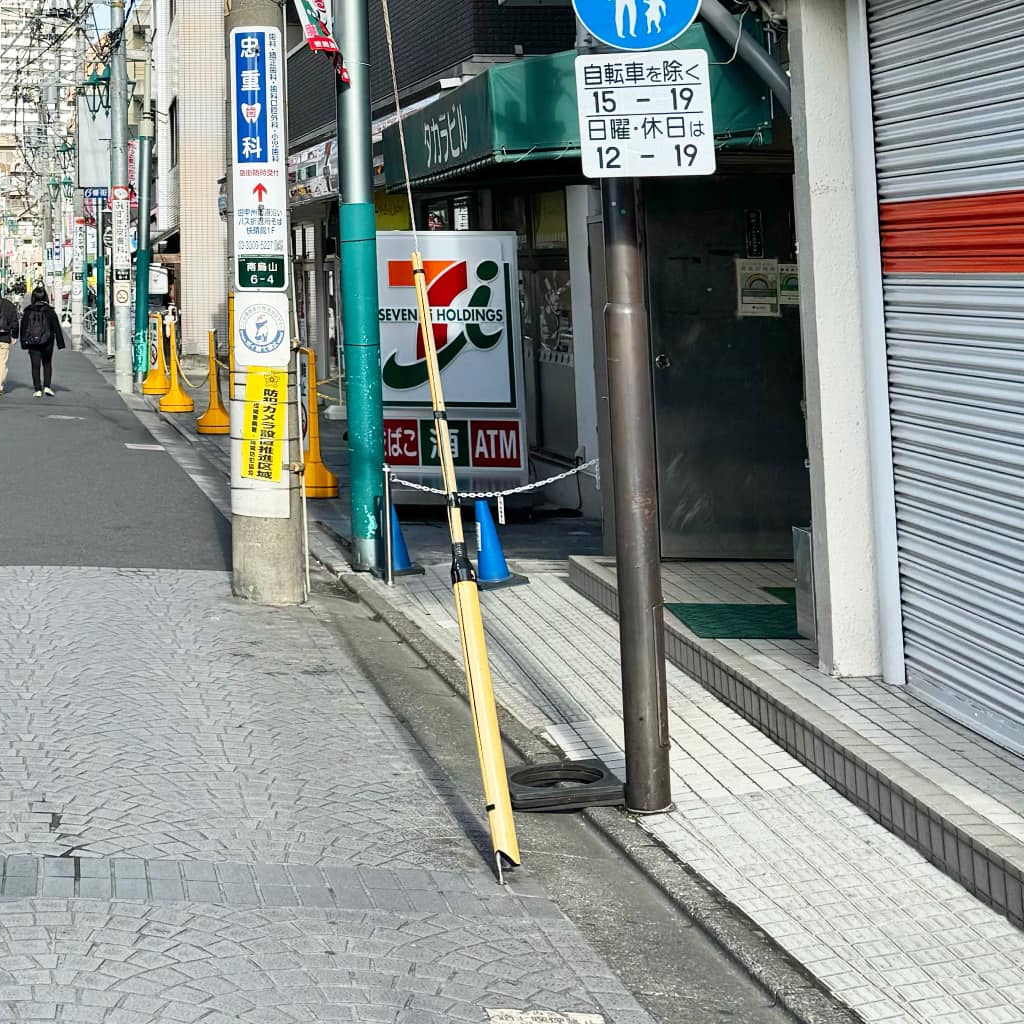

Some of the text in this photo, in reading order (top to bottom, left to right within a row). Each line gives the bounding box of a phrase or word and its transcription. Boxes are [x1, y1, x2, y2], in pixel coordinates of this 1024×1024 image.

[584, 60, 700, 85] 自転車を除く
[593, 90, 616, 113] 15
[671, 87, 694, 111] 19
[424, 104, 467, 168] タカラビル
[588, 117, 705, 140] 日曜・休日は
[597, 146, 621, 168] 12
[675, 144, 698, 167] 19
[250, 274, 274, 284] 6-4
[379, 308, 418, 321] SEVEN
[436, 308, 503, 322] HOLDINGS
[384, 428, 418, 458] ばこ
[474, 429, 517, 459] ATM
